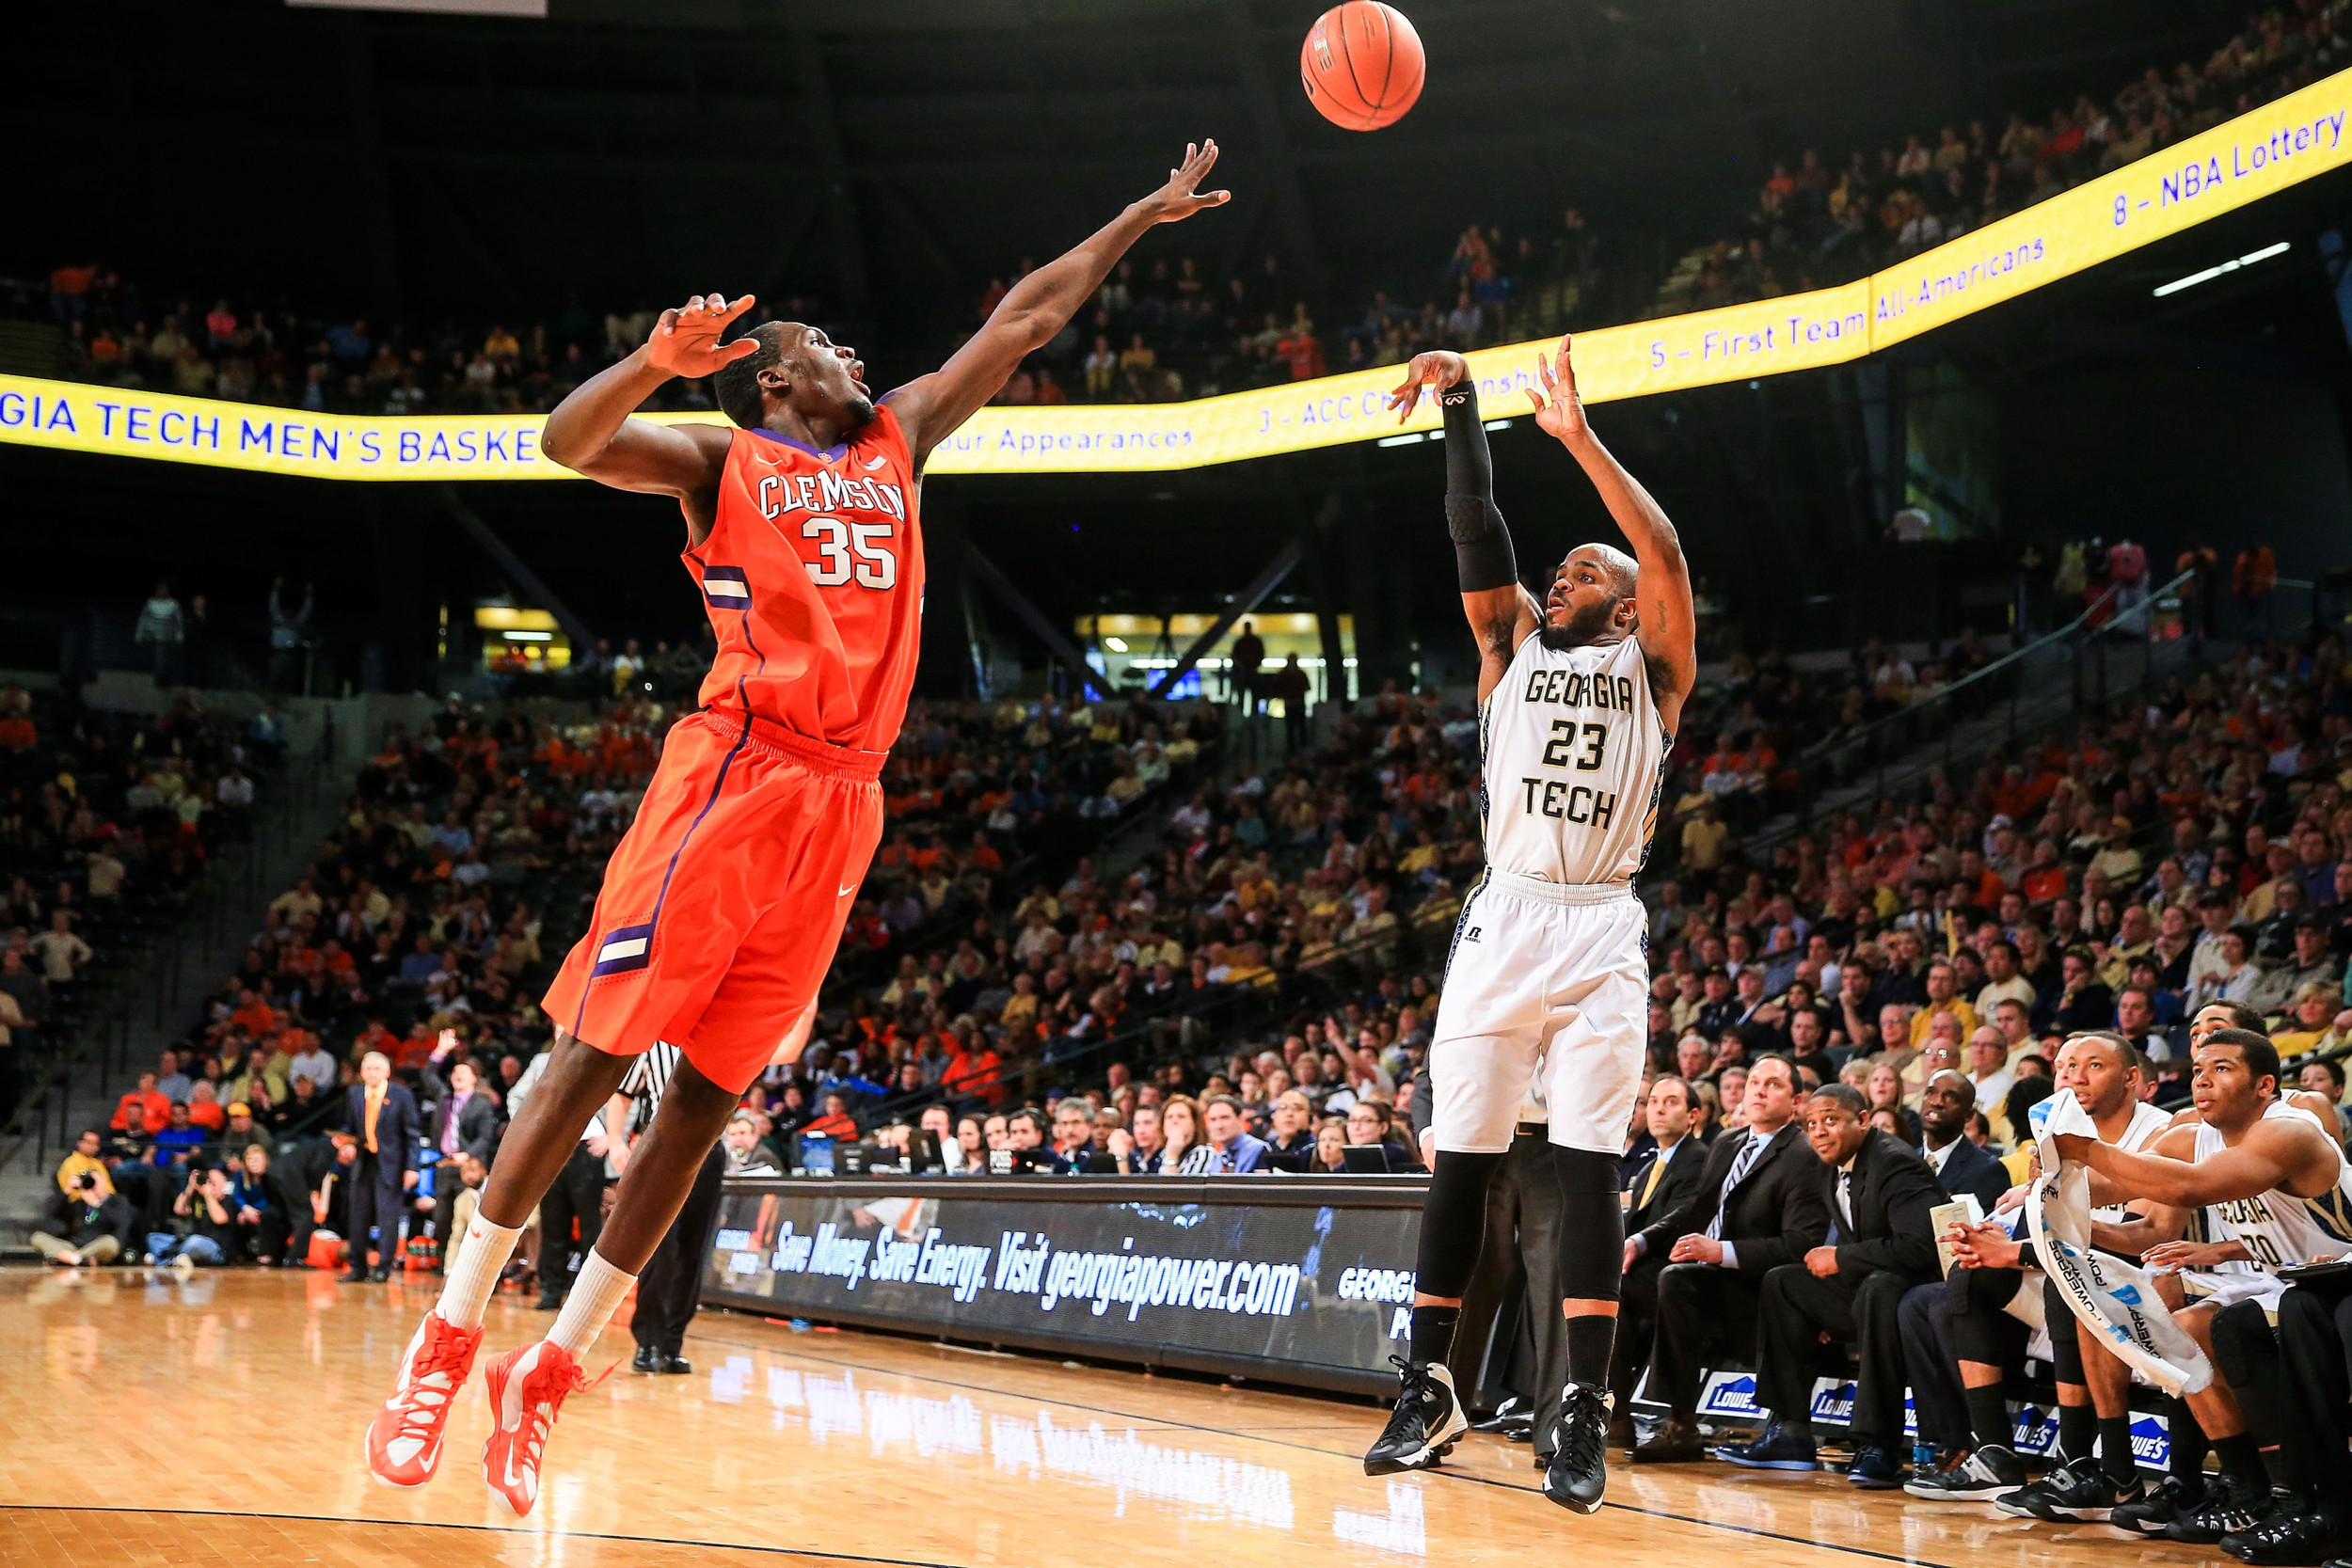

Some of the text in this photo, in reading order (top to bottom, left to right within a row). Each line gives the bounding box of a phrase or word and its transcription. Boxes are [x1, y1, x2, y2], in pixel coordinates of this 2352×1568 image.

[2114, 195, 2126, 226] 8
[2162, 155, 2223, 207] NBA
[2234, 110, 2345, 178] Lottery
[1650, 340, 1666, 369] 5
[1703, 325, 1774, 360] First
[1788, 310, 1866, 346] Team
[1875, 236, 2045, 322] All-Americans
[0, 391, 536, 463] GIA TECH MEN'S BASKE
[1259, 409, 1270, 434] 3
[1301, 395, 1353, 424] ACC
[998, 428, 1194, 458] Appearances
[758, 469, 906, 524] CLEMSON
[802, 517, 896, 590] 35
[1525, 669, 1633, 715] GEORGIA
[1541, 719, 1609, 773] 23
[1521, 777, 1616, 831] TECH
[771, 1220, 813, 1273] Save
[869, 1225, 920, 1283] Save
[914, 1227, 992, 1303] Energy.
[993, 1230, 1049, 1294] Visit
[1041, 1236, 1301, 1322] georgiapower.com
